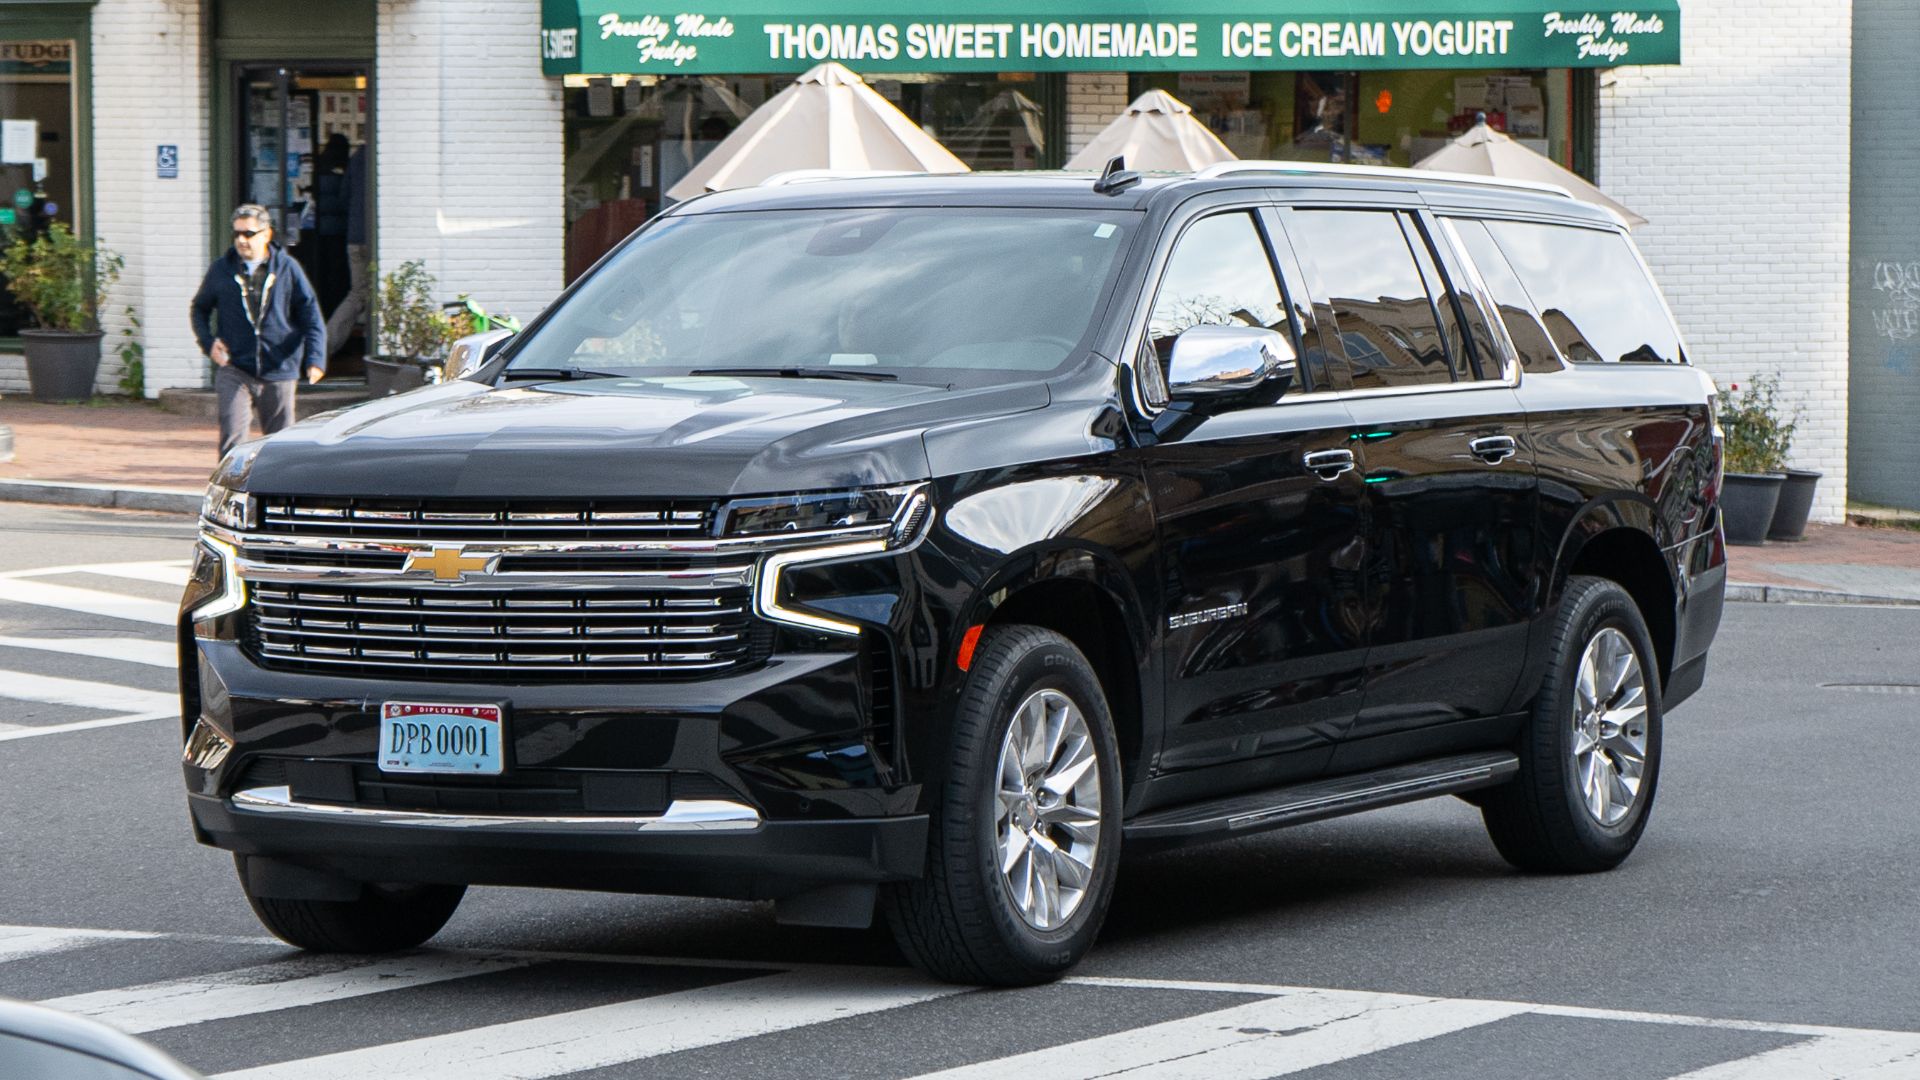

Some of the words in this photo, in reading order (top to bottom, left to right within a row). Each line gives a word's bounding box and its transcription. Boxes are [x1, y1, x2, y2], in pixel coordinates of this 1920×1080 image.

[598, 13, 670, 41] Freshly
[674, 13, 734, 37] Made
[1543, 12, 1607, 38] Freshly
[1610, 12, 1664, 36] Made
[636, 37, 697, 67] Fudge
[763, 23, 900, 60] THOMAS
[905, 23, 1014, 59] SWEET
[1020, 22, 1198, 58] HOMEMADE
[1222, 22, 1273, 57] ICE
[1279, 22, 1385, 57] CREAM
[1391, 20, 1513, 56] YOGURT
[1576, 35, 1629, 63] Fudge
[1169, 602, 1248, 629] SUBURBAN
[419, 706, 465, 715] DIPLOMAT
[391, 722, 489, 757] DPB0001
